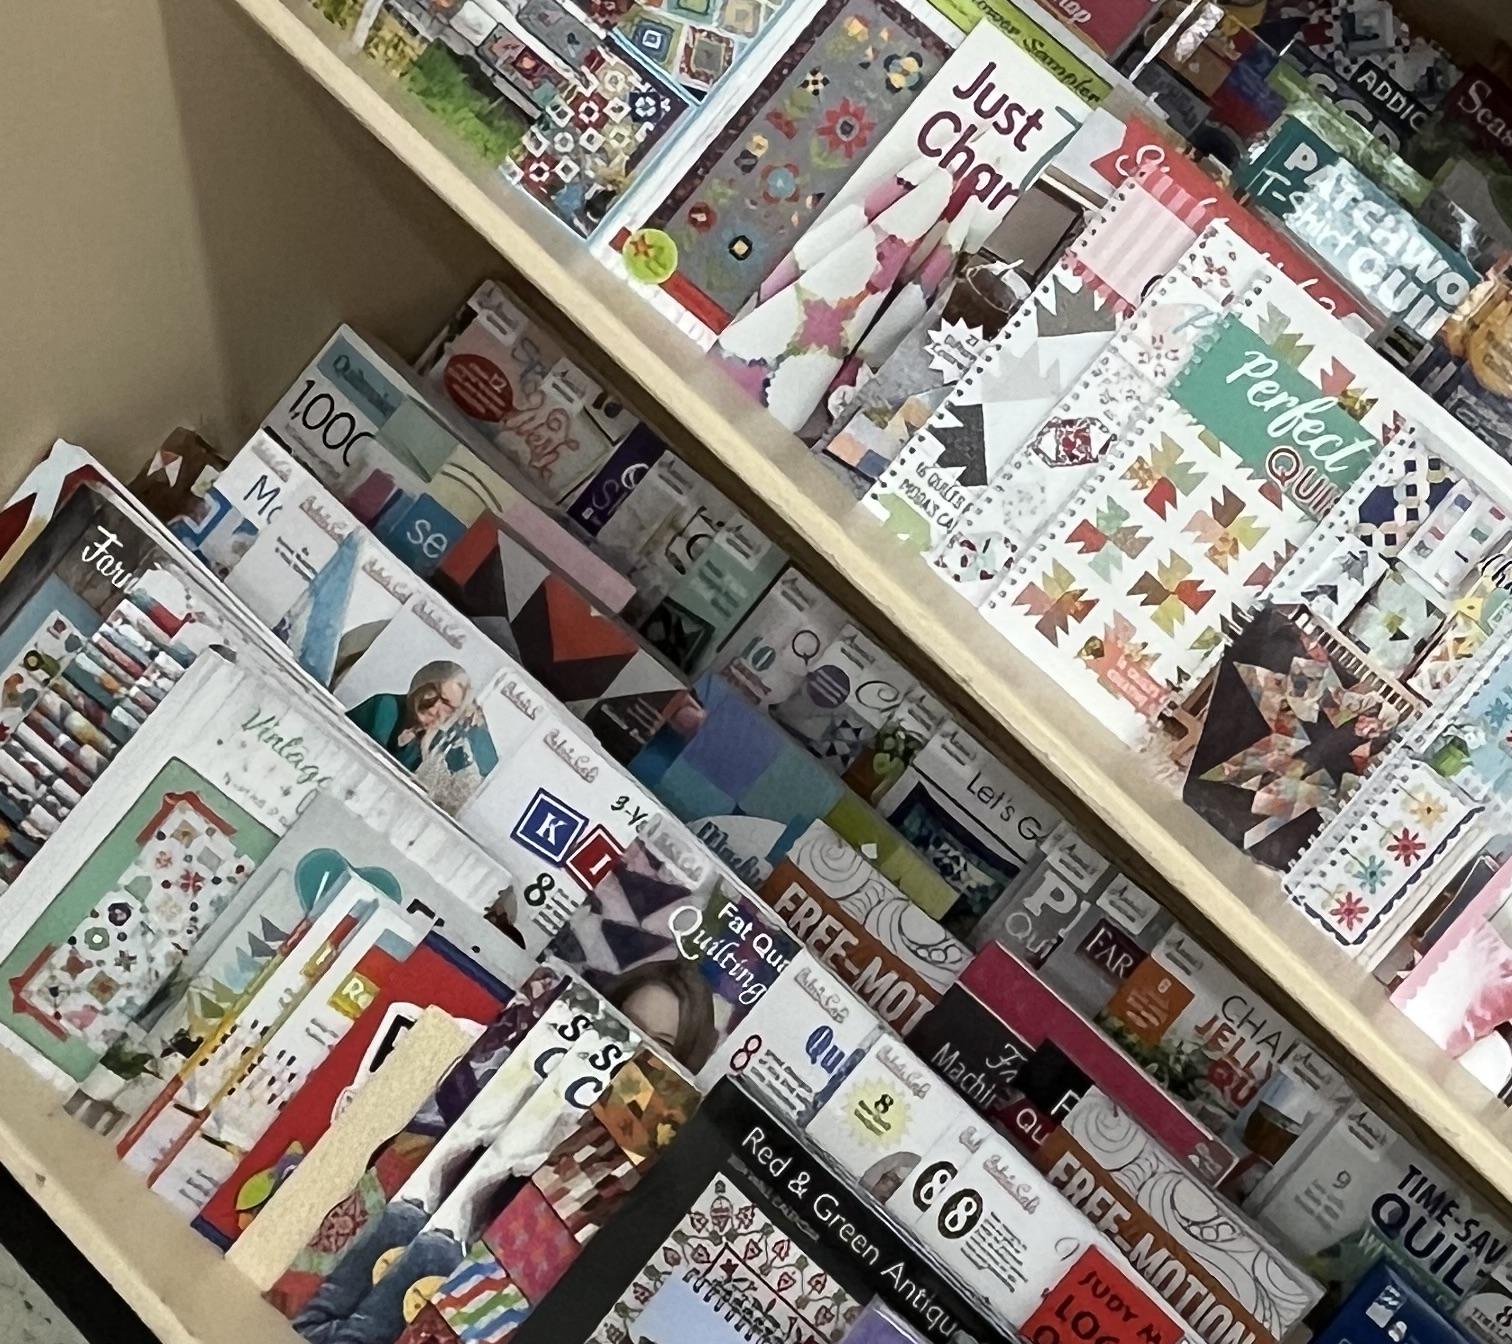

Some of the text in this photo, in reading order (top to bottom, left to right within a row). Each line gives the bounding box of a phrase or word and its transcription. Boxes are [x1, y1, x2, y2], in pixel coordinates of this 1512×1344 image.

[953, 61, 1045, 152] Just
[524, 872, 556, 906] 8
[717, 901, 754, 941] Fat
[668, 905, 767, 1005] Quilting
[729, 1034, 762, 1074] 8
[741, 1126, 793, 1178] Red
[787, 1171, 813, 1198] &
[812, 1193, 882, 1267] Green
